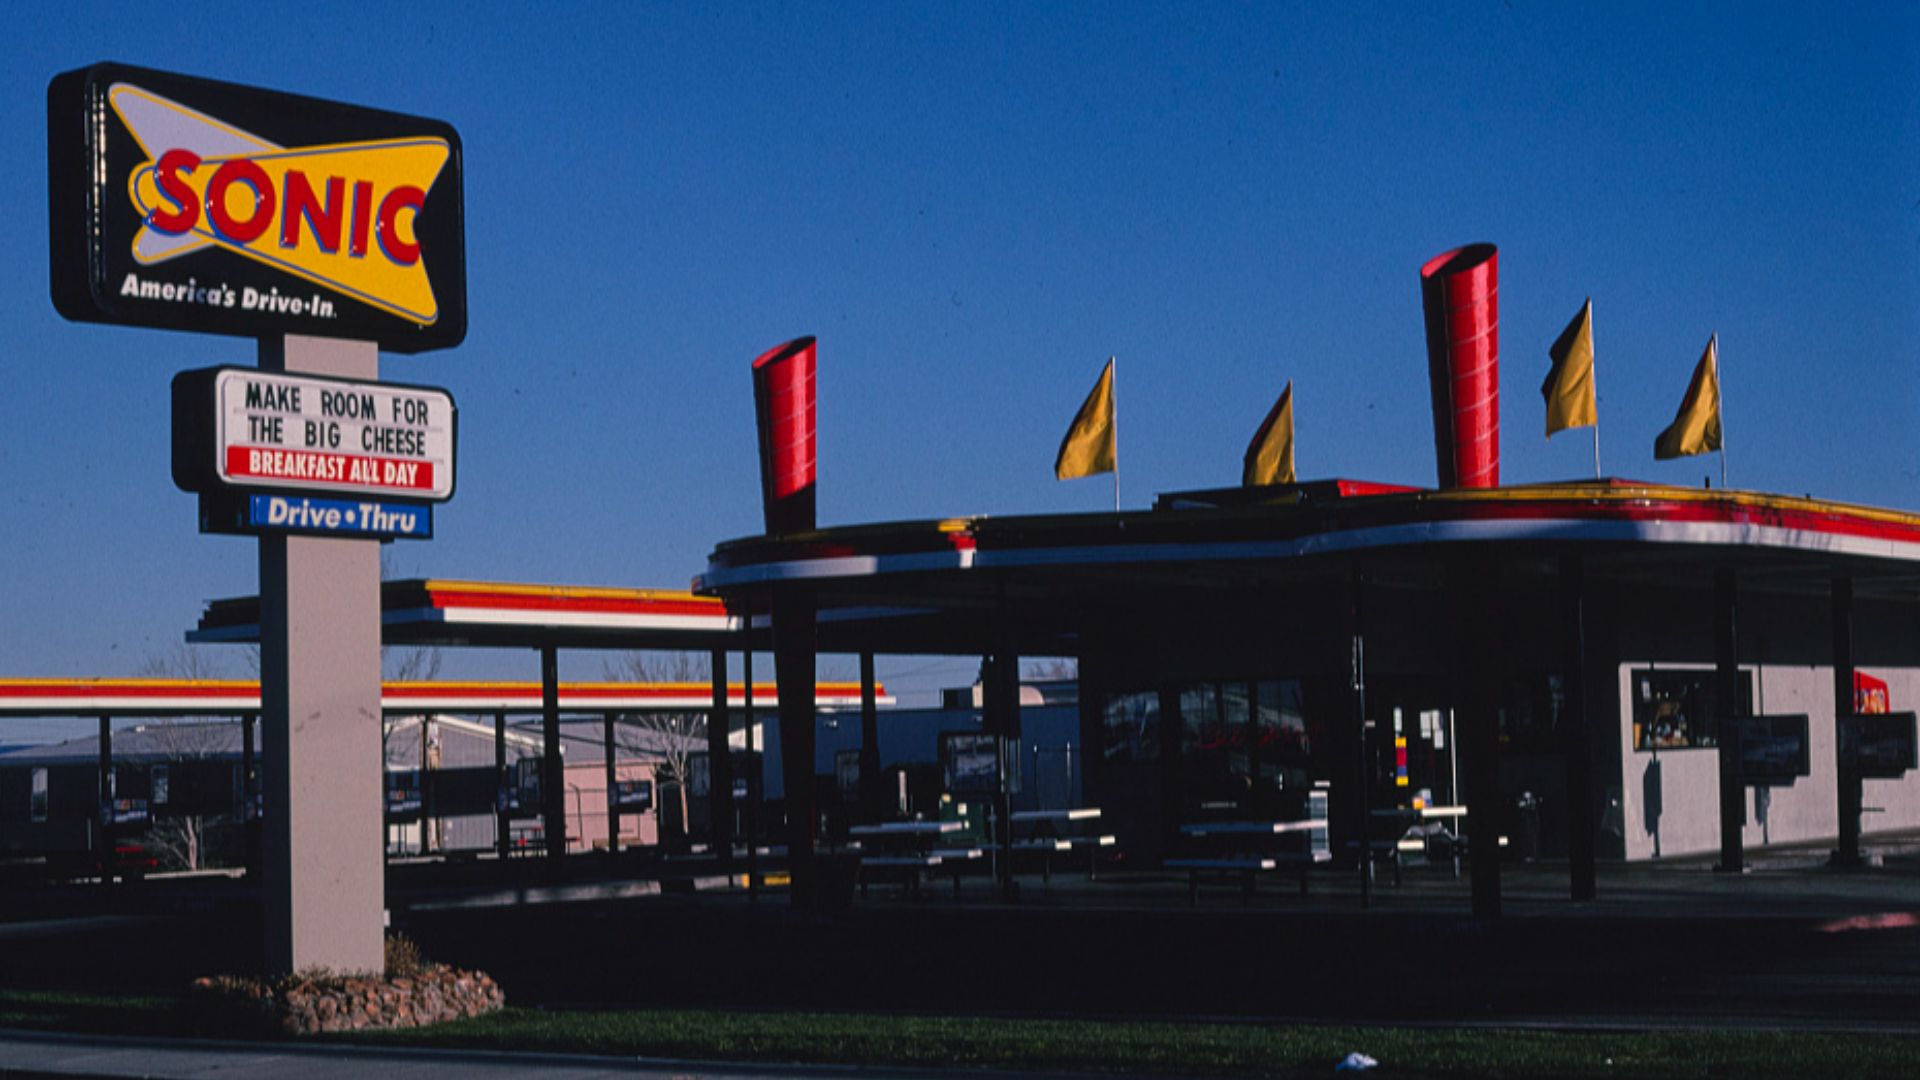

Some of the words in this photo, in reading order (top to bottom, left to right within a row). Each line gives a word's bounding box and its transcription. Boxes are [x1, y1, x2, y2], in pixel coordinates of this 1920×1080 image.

[141, 148, 426, 267] SONIC
[120, 273, 235, 307] America's
[245, 382, 300, 413] MAKE
[321, 390, 376, 420] ROOM
[392, 398, 428, 426] FOR
[248, 416, 283, 444] THE
[305, 421, 341, 448] BIG
[361, 426, 425, 456] CHEESE
[249, 450, 346, 480] BREAKFAST
[350, 460, 380, 484] ALL
[383, 462, 418, 486] DAY
